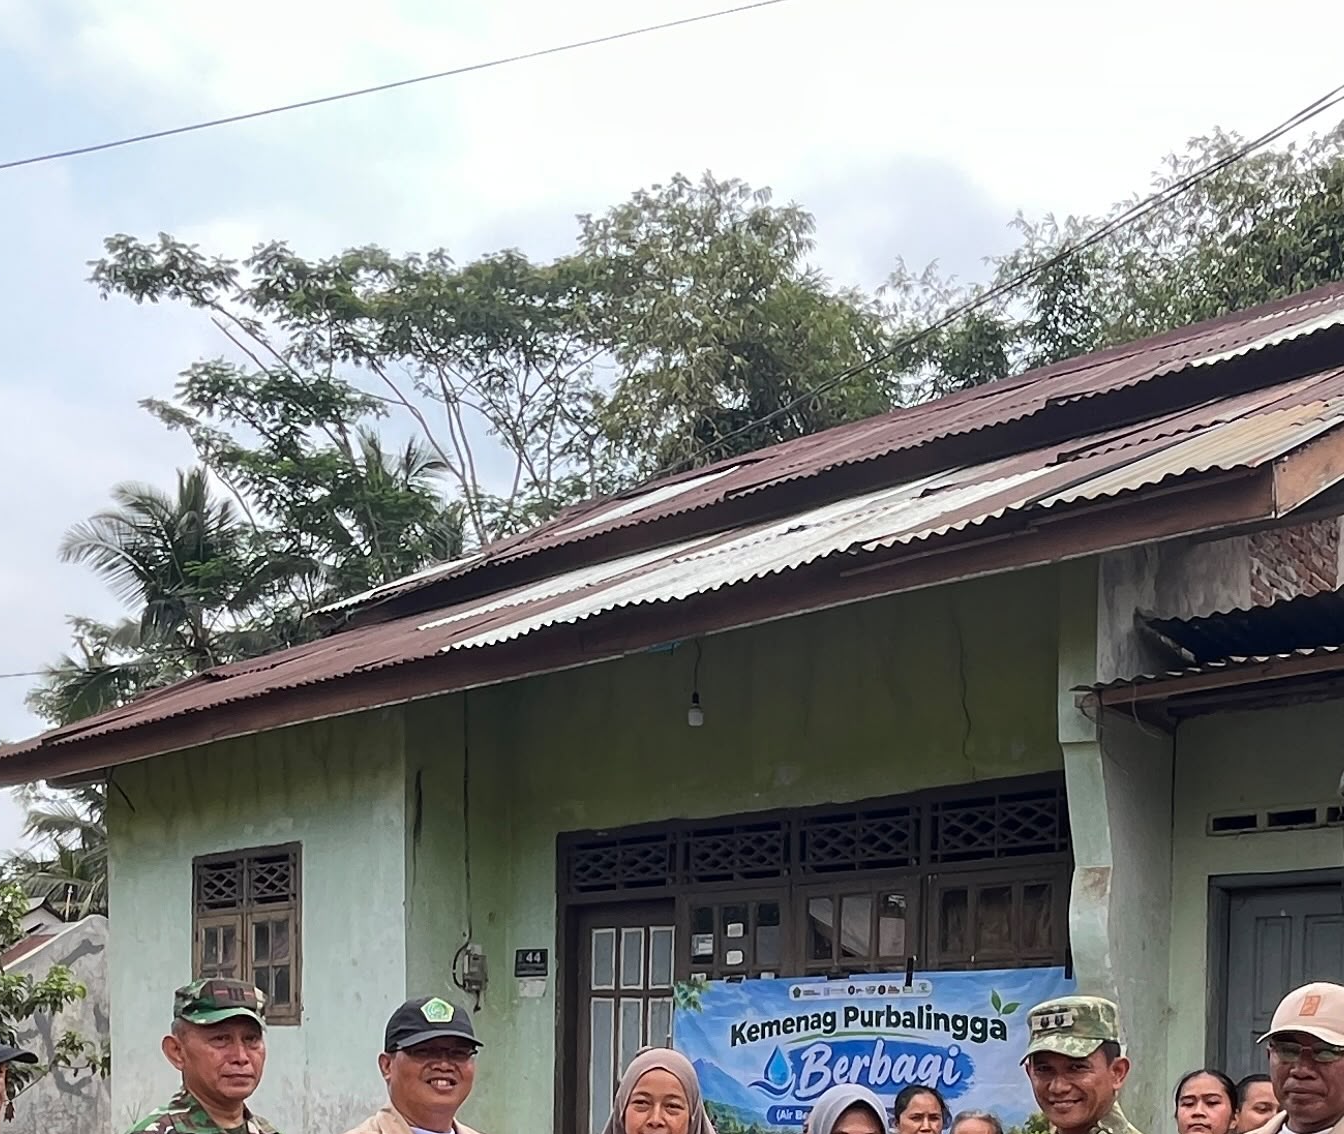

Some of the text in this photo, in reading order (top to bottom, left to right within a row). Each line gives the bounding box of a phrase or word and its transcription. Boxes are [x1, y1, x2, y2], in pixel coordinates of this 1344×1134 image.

[526, 952, 541, 963] 44
[730, 1004, 1008, 1047] Kemenag Purbalingga
[794, 1043, 961, 1099] Berbagi
